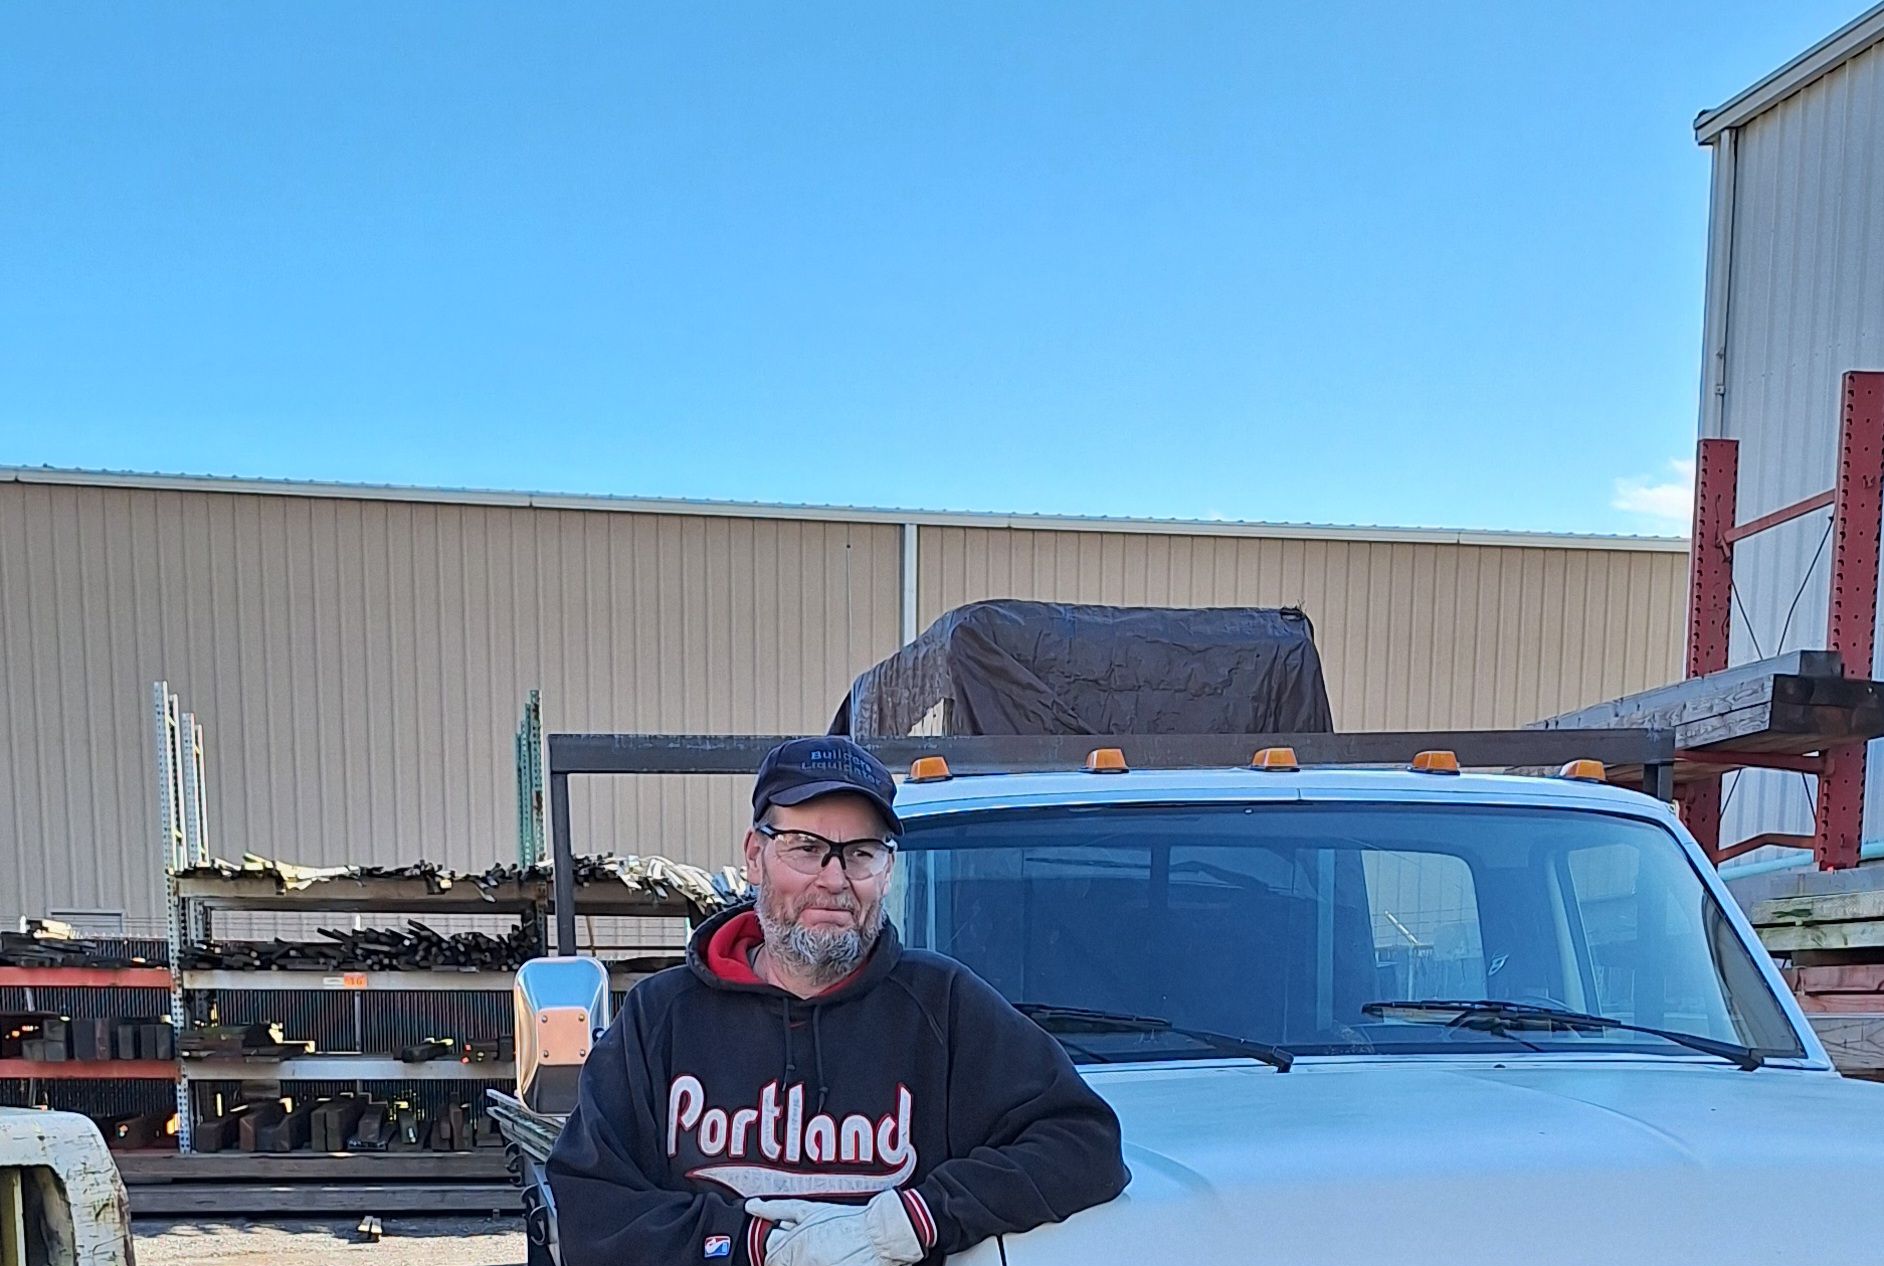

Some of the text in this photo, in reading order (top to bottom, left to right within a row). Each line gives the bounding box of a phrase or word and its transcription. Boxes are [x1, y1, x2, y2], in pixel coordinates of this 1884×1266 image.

[801, 761, 882, 785] Liquidator
[810, 749, 872, 773] Builders
[667, 1073, 913, 1166] Portland
